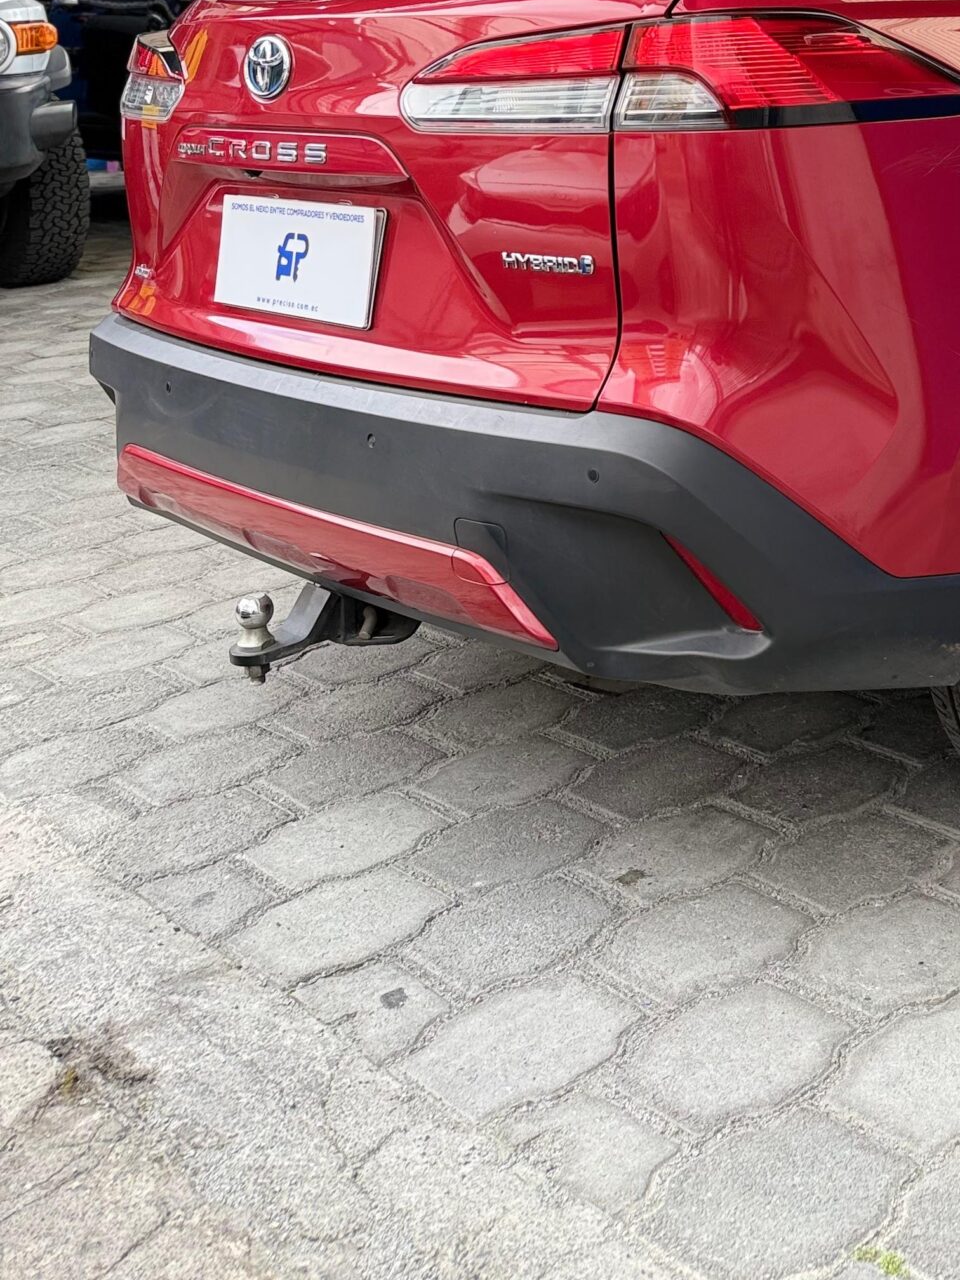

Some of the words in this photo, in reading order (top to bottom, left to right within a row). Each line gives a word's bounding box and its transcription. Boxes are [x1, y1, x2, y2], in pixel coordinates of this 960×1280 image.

[207, 136, 327, 164] CROSS
[231, 202, 249, 211] SOMOS
[249, 204, 255, 212] EL
[270, 206, 286, 216] ENTRE
[286, 207, 325, 219] COMPRADORES
[330, 212, 365, 223] VENDEDORES
[501, 251, 580, 273] HYBRID
